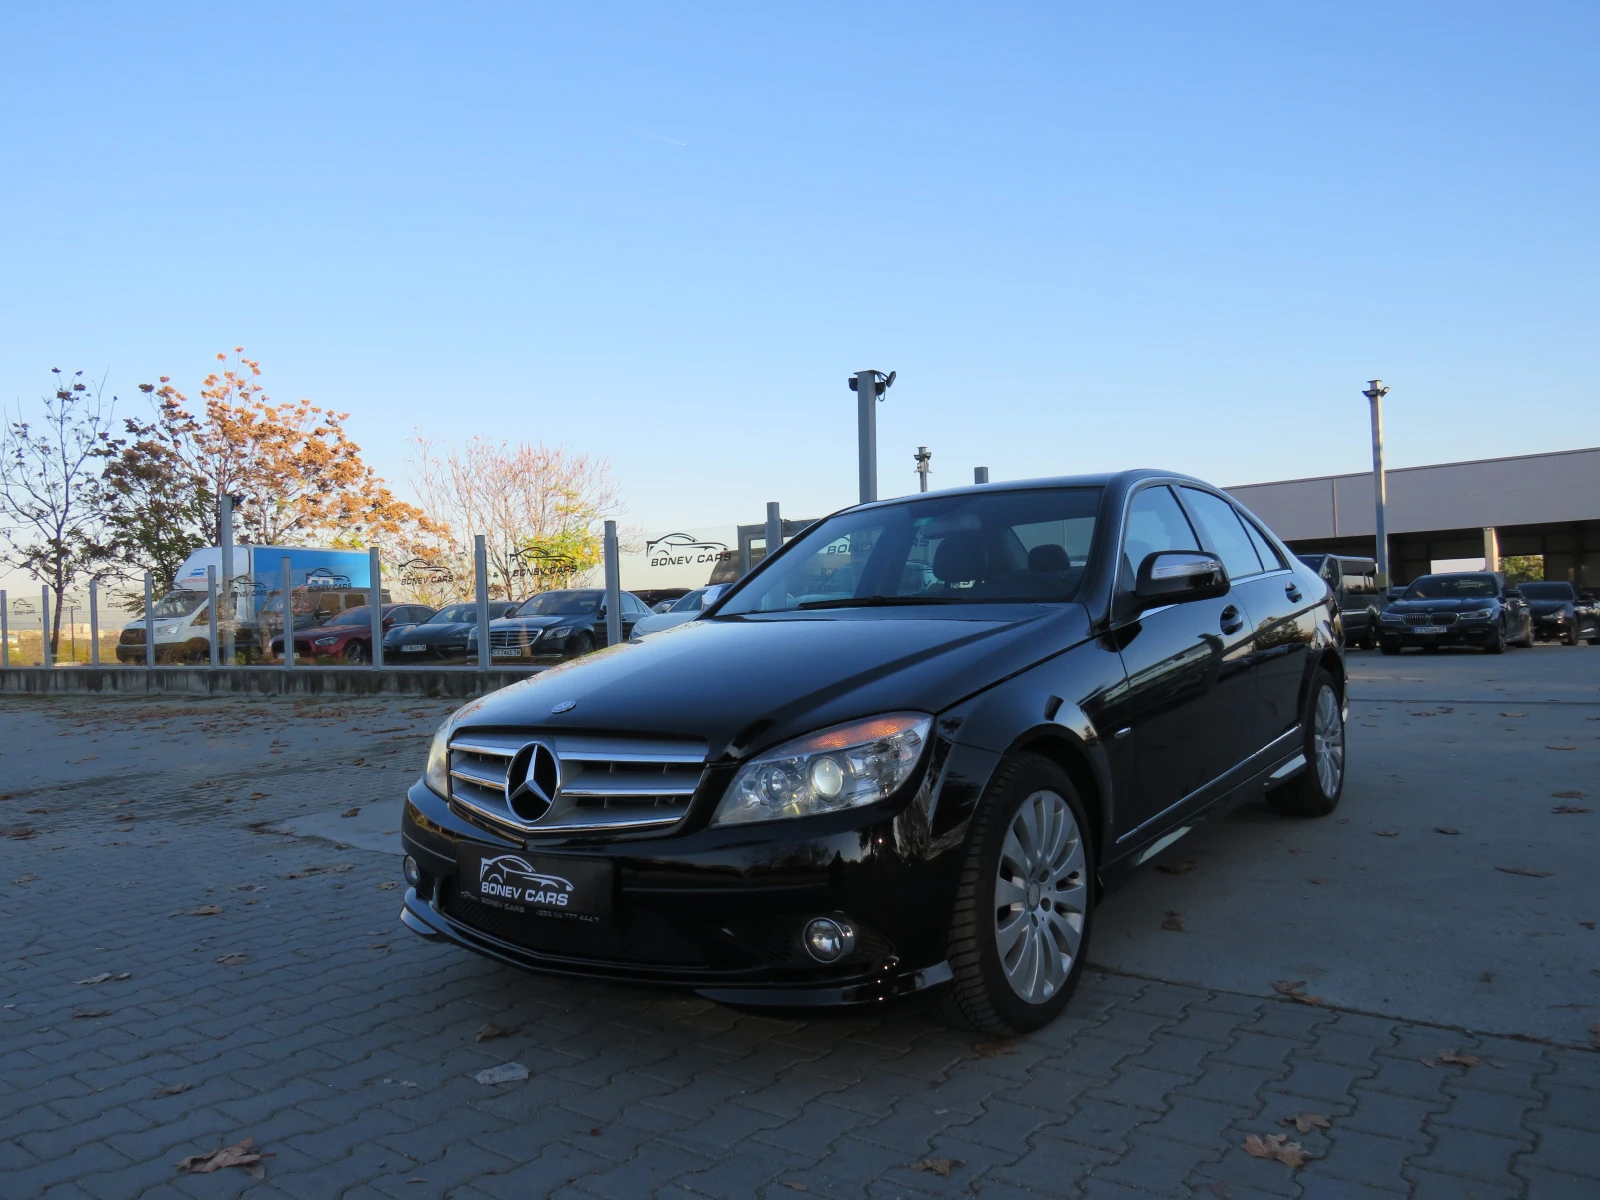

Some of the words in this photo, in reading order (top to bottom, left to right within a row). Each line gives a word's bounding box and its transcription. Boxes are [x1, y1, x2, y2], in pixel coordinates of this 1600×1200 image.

[650, 555, 693, 567] BONEV
[697, 552, 732, 563] CARS
[512, 567, 547, 577] BONEV
[549, 564, 578, 575] CARS
[400, 577, 430, 586] BONEV
[431, 574, 454, 584] CARS
[251, 589, 268, 597] CARS
[308, 585, 332, 593] BONEV
[332, 582, 352, 591] CARS
[480, 881, 522, 899] BONEV
[524, 889, 569, 906] CARS
[481, 898, 503, 908] BONEV
